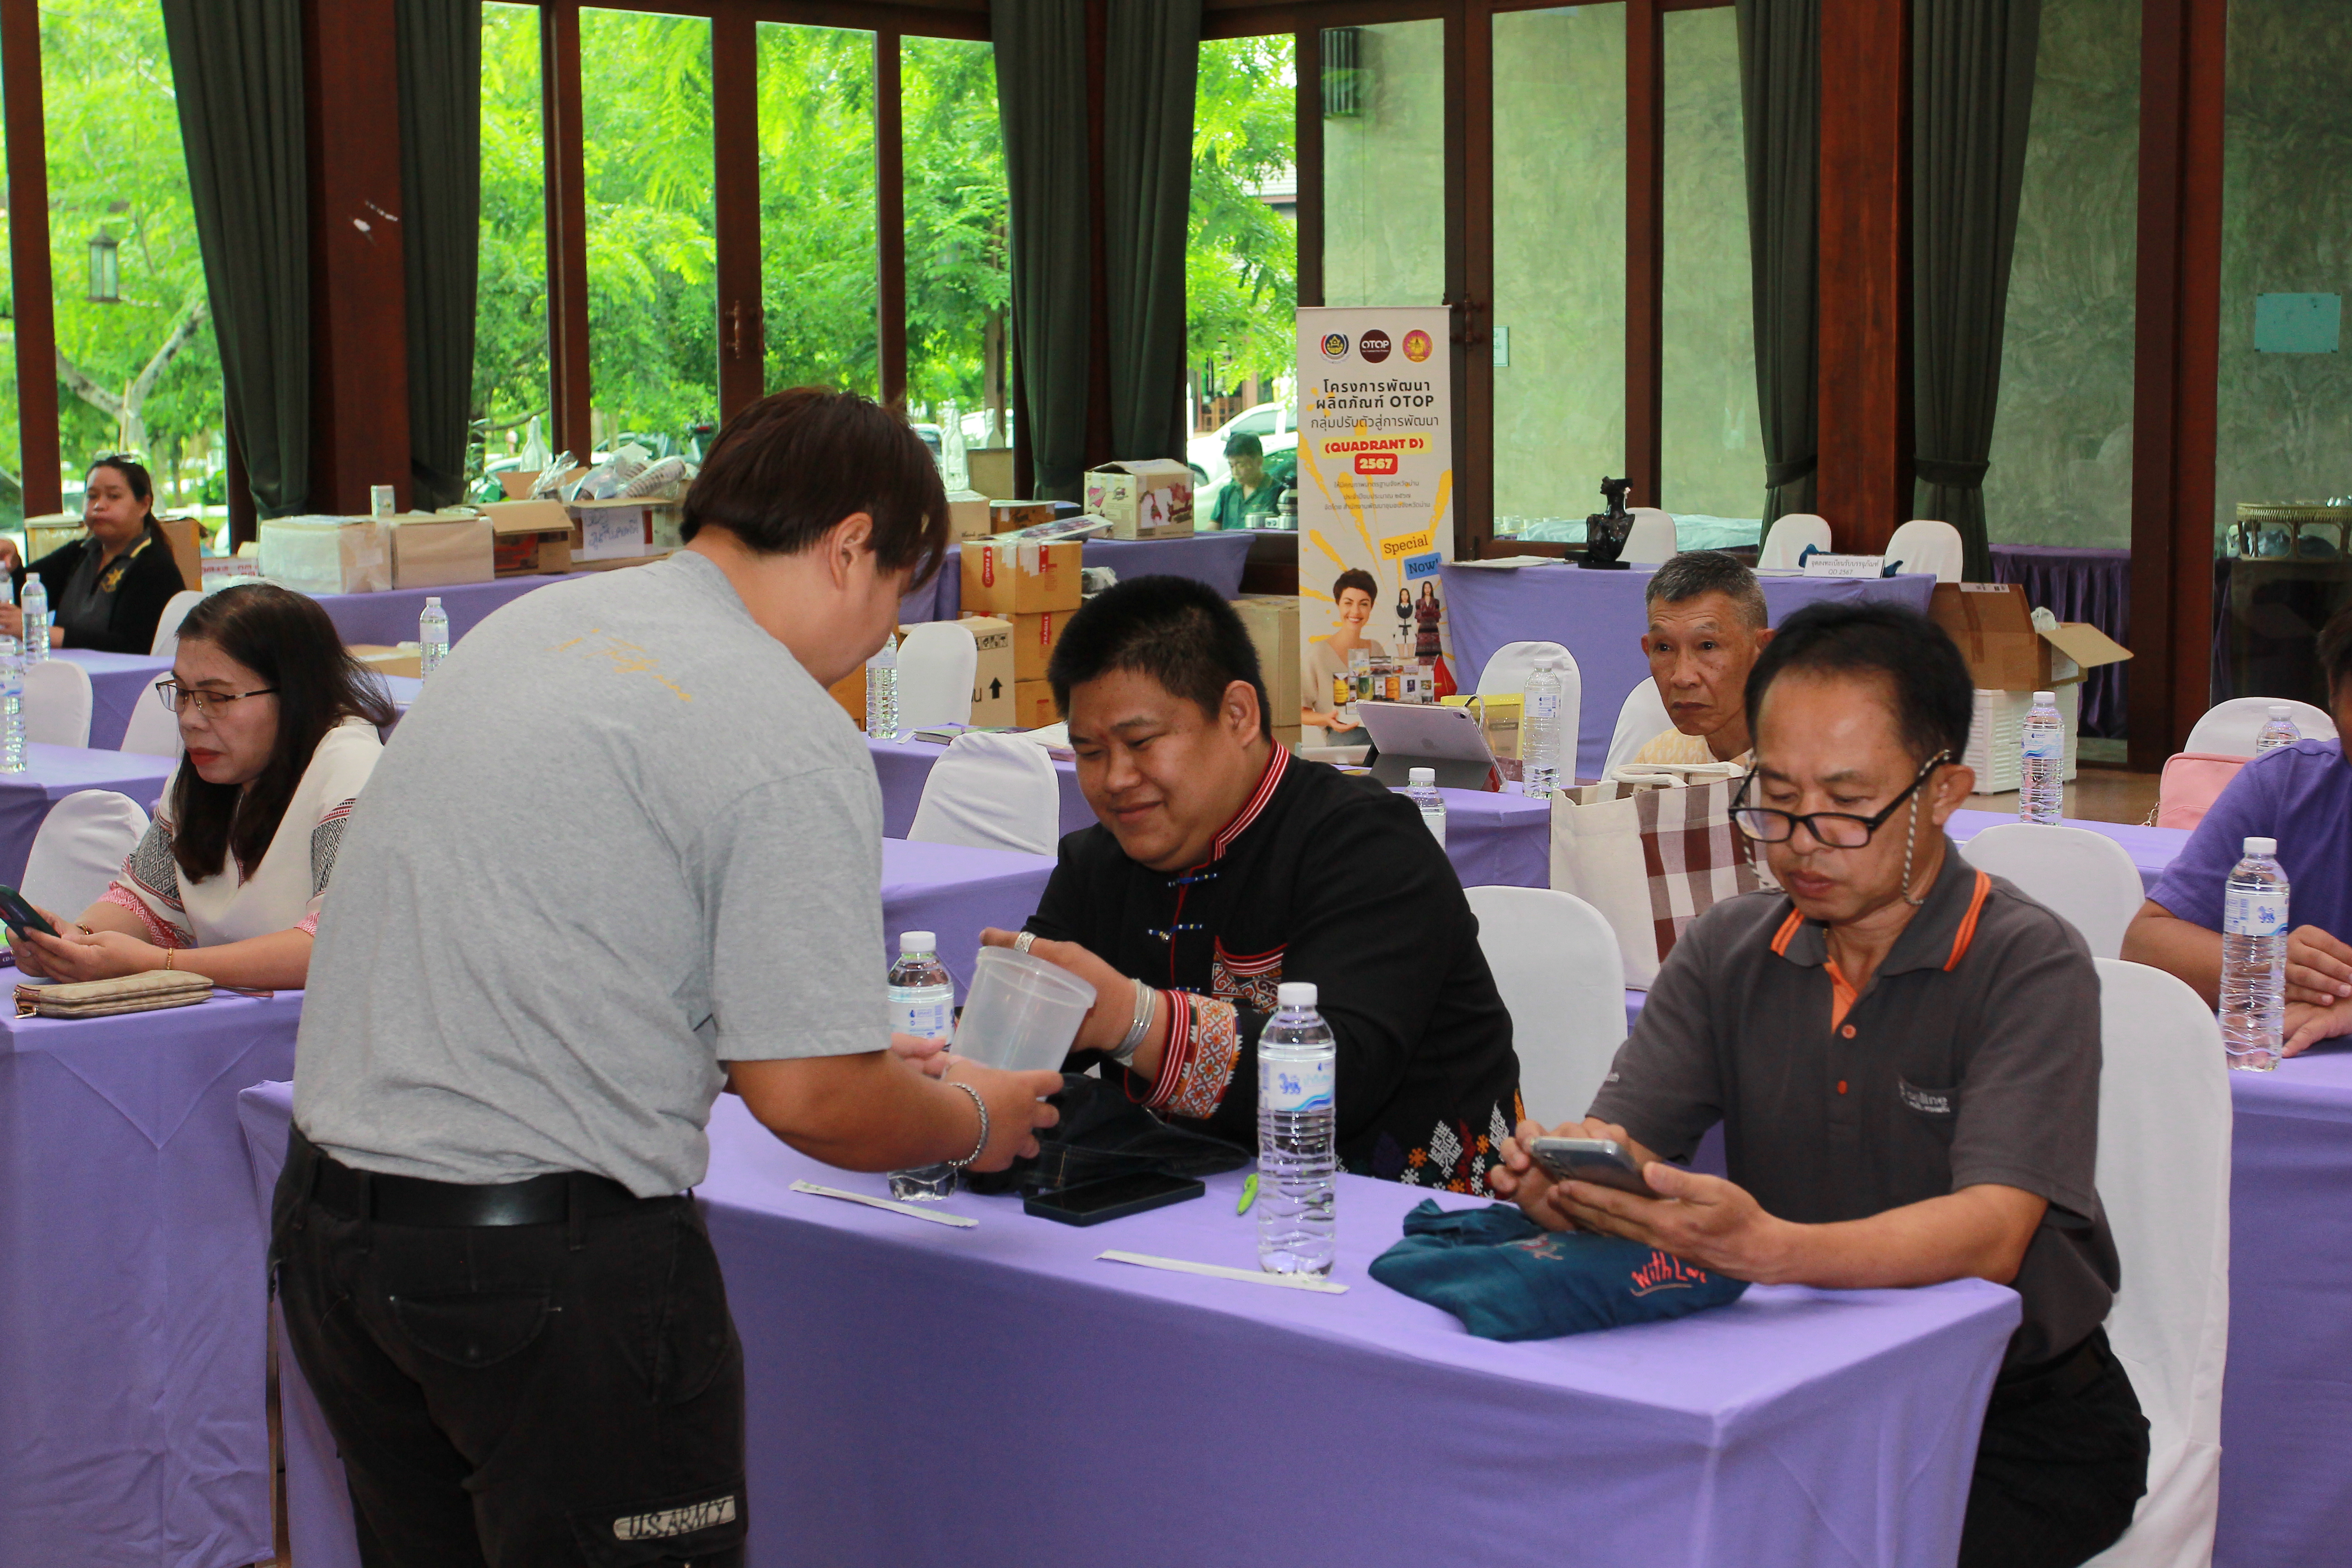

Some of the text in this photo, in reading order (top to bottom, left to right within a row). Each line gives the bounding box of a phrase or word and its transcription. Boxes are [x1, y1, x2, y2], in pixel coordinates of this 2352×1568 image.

[1362, 340, 1389, 348] OTOP
[1323, 378, 1430, 393] โครงการพัฒนา
[1317, 395, 1434, 408] ผลิตภัณฑ์ OTOP
[1311, 414, 1439, 431] กลุ่มปรับตัวสู่การพัฒนา
[1325, 438, 1424, 453] (QUADRANT D)
[1359, 458, 1393, 469] 2567
[1384, 534, 1429, 555] Special
